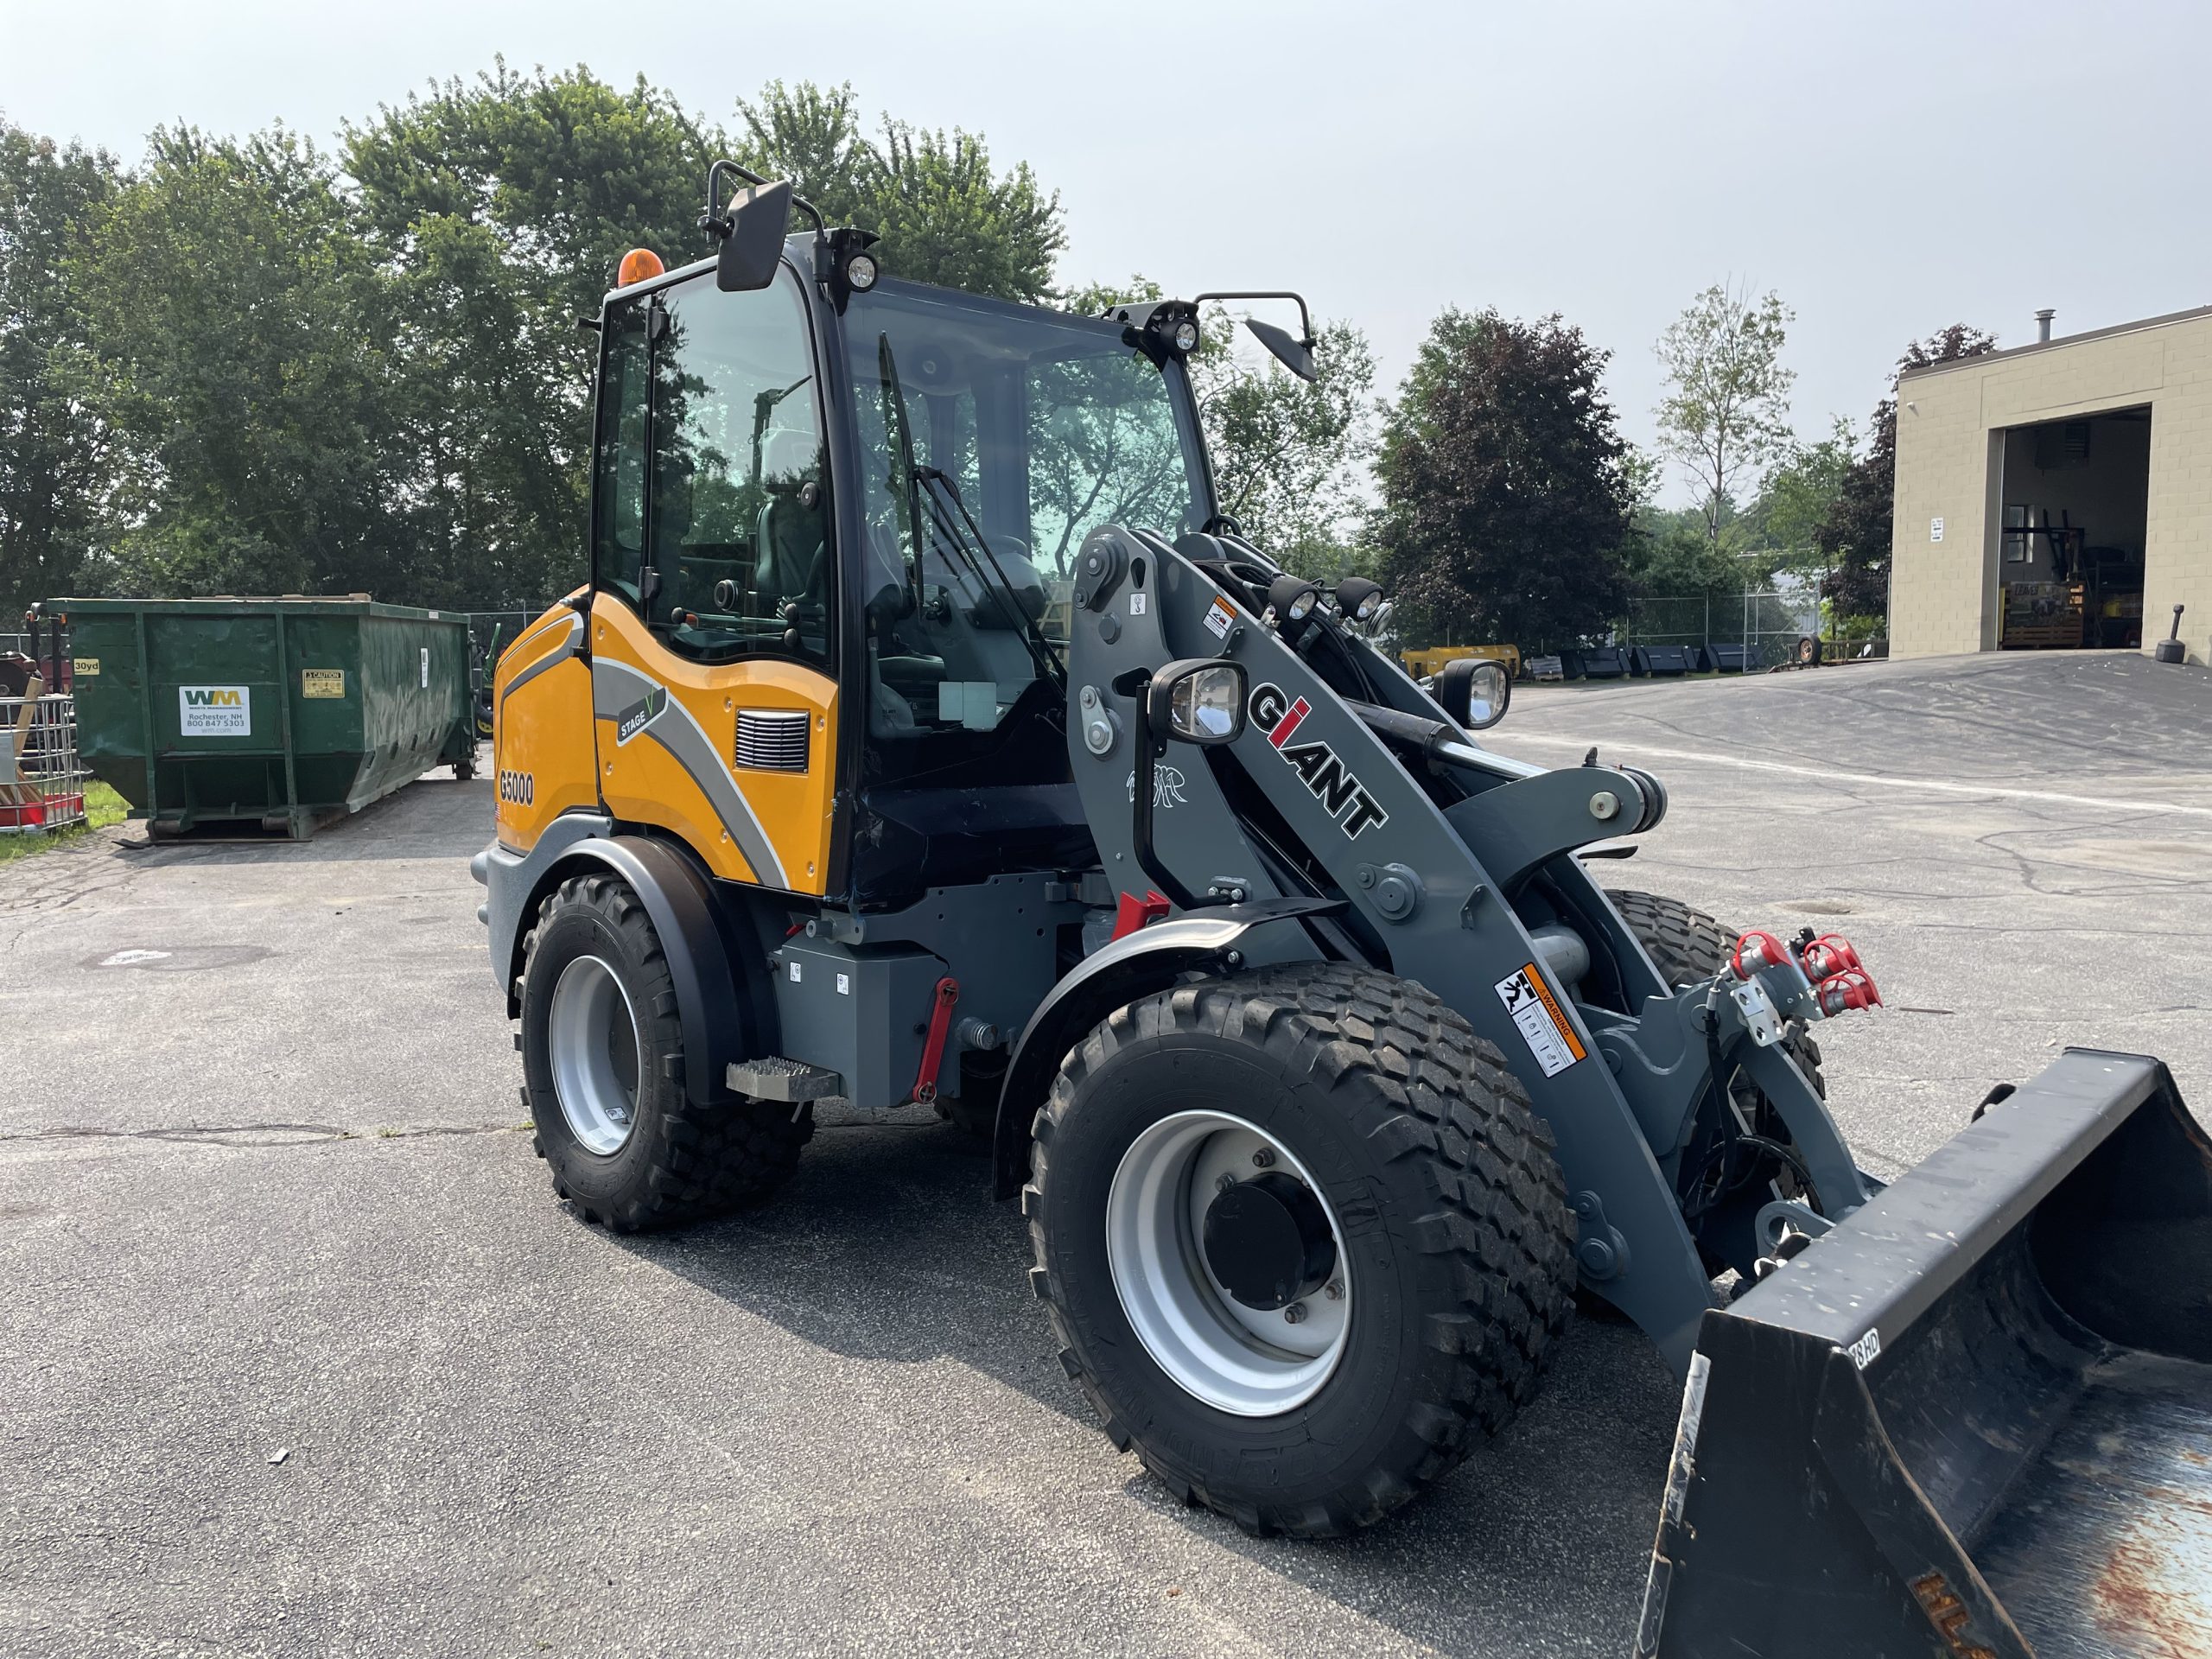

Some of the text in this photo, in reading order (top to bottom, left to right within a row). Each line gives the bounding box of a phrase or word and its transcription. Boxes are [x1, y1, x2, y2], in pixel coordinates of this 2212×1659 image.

[75, 662, 99, 671] 30yd
[185, 690, 241, 705] WM
[621, 710, 645, 736] STAGE
[500, 769, 533, 806] G5000
[1543, 994, 1571, 1036] WARNING
